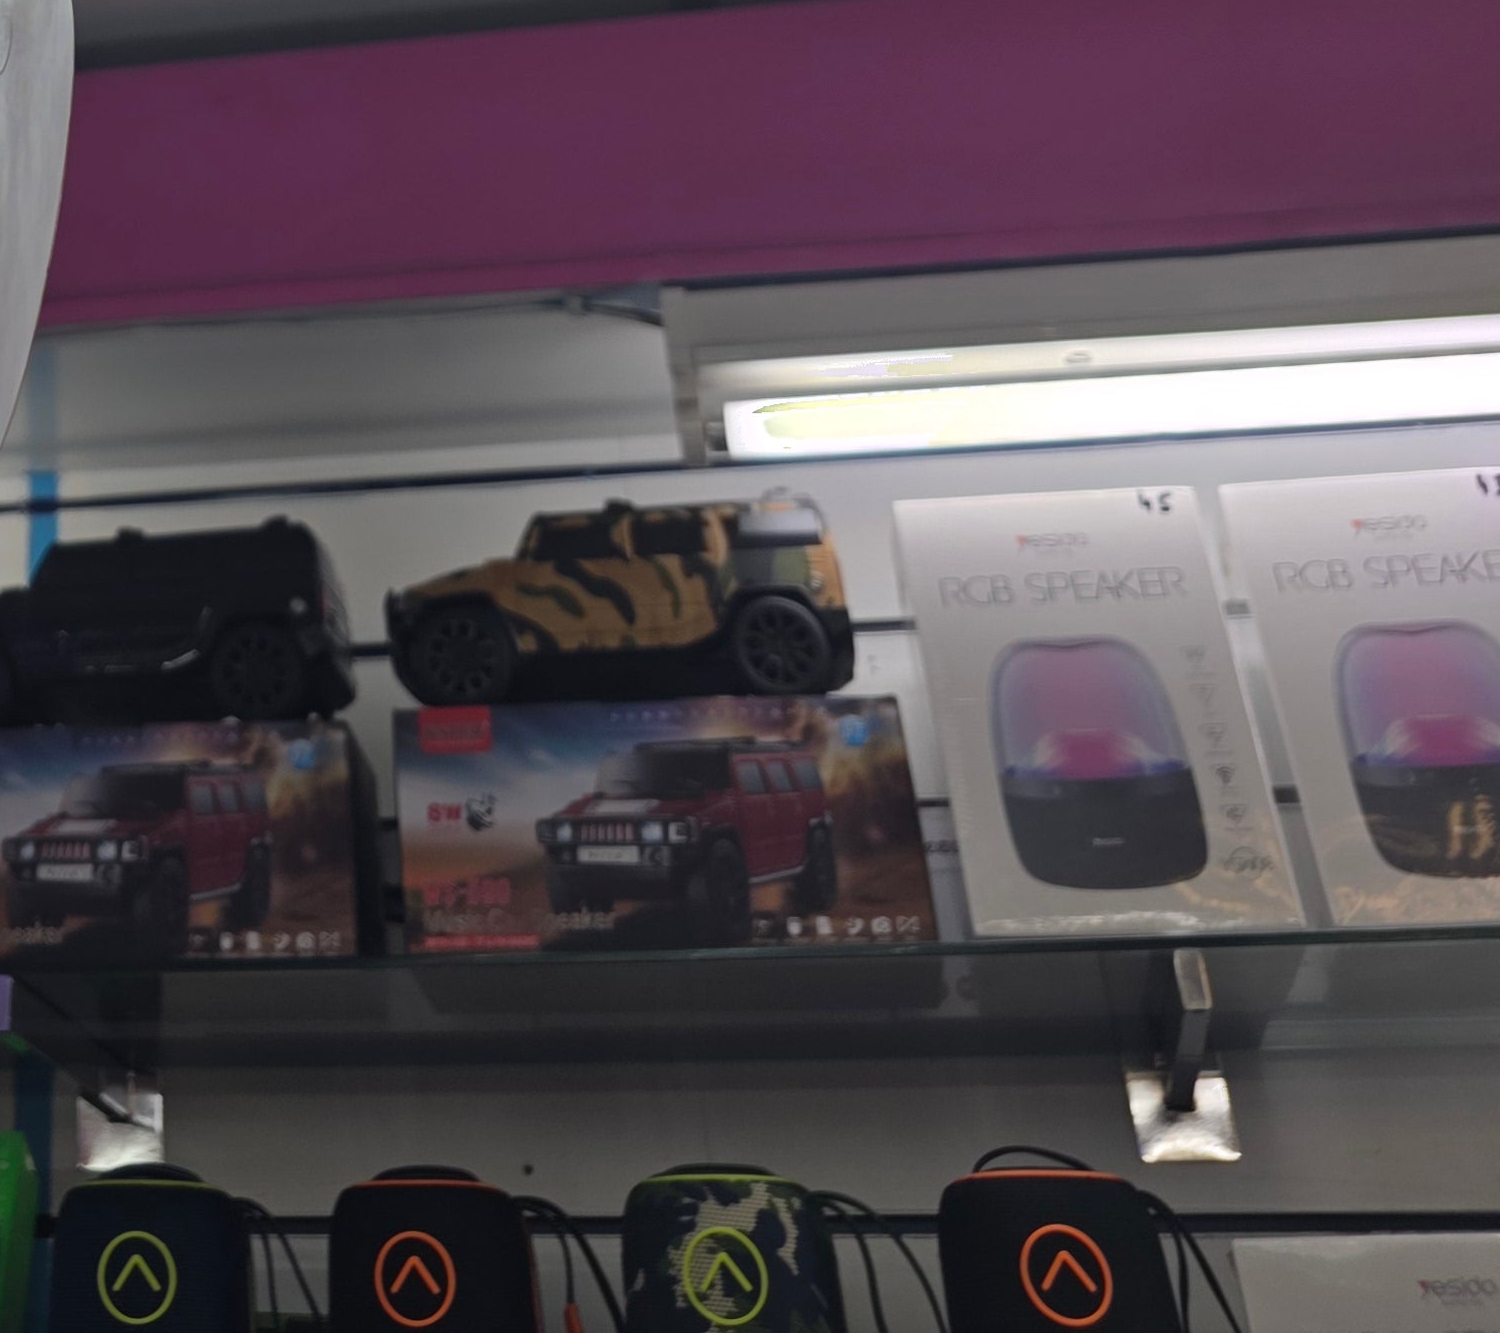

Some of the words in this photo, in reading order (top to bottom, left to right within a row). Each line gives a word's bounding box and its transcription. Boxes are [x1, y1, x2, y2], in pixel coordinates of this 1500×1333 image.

[938, 574, 1016, 608] RGB
[1023, 566, 1191, 604] SPEAKER
[1272, 557, 1354, 593] RGB
